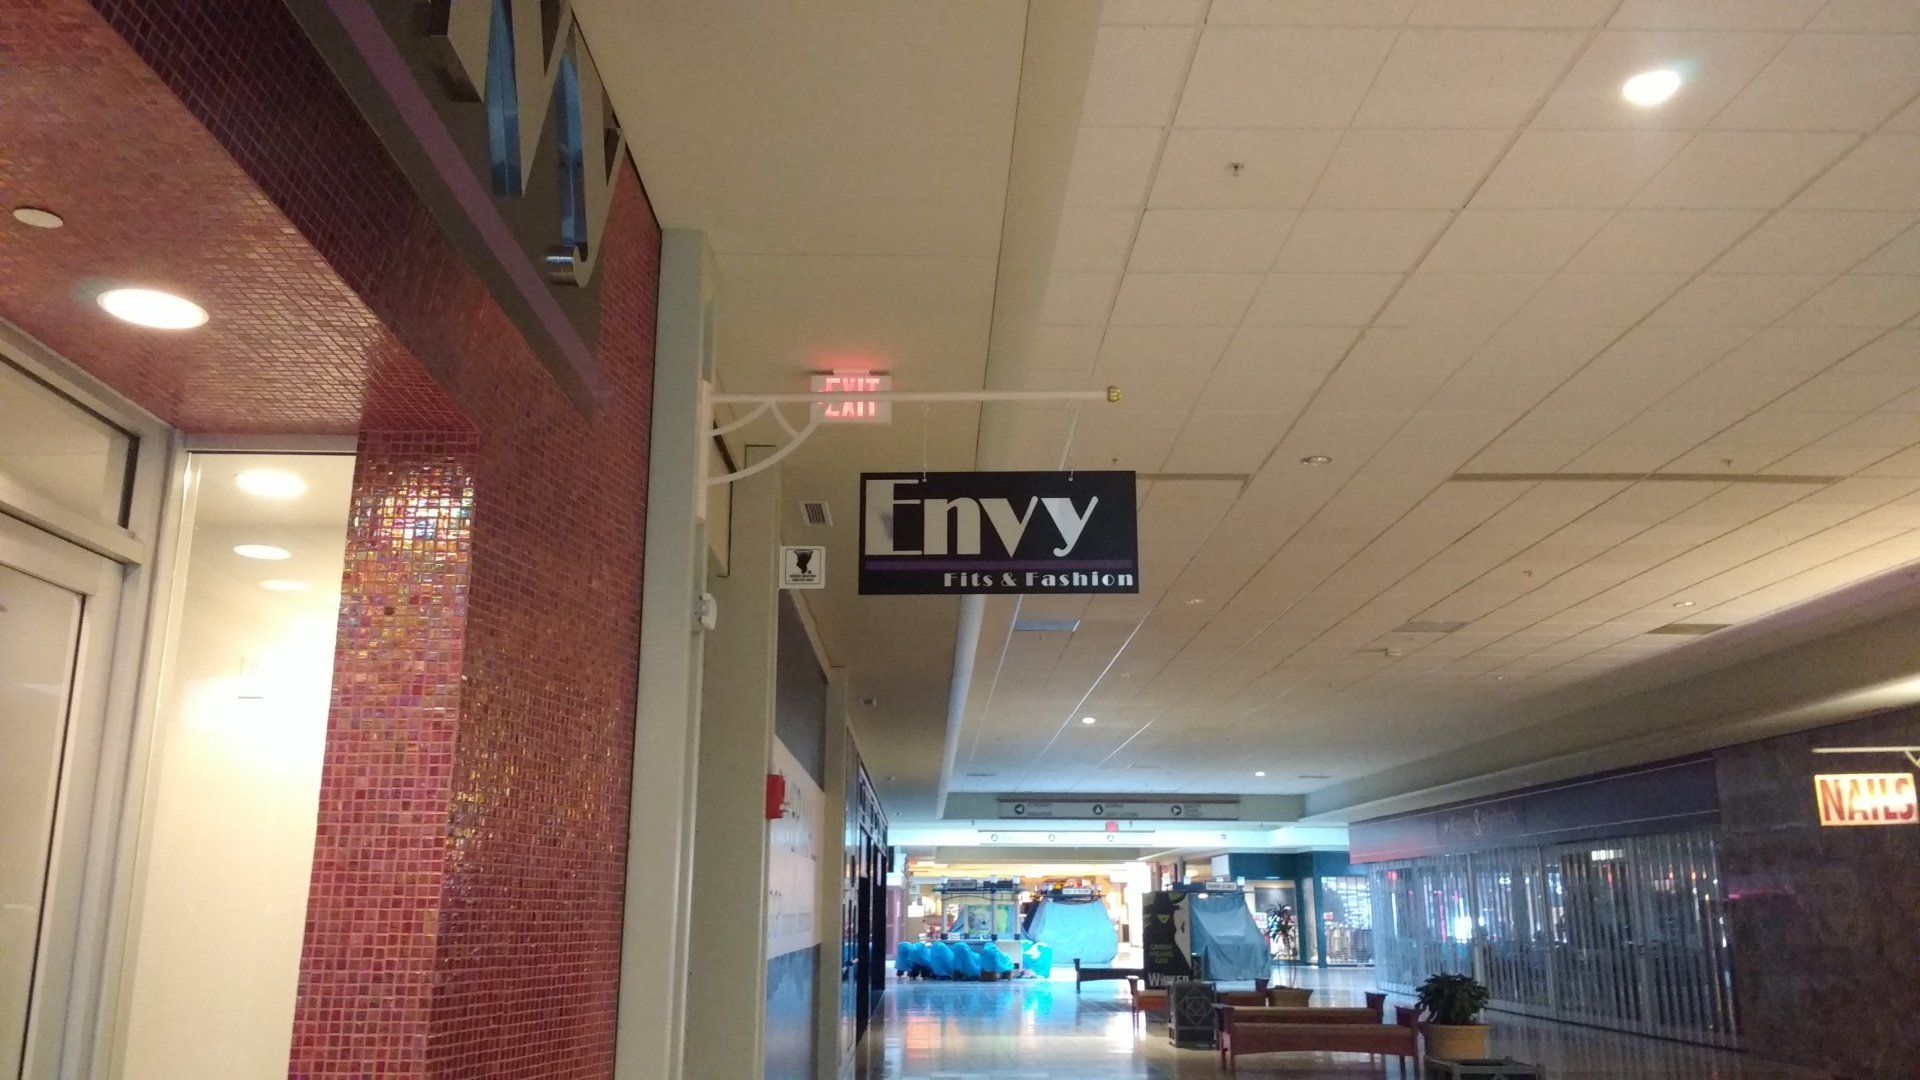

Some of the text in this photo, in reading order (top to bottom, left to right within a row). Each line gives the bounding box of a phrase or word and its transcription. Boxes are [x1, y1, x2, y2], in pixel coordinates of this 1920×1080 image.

[825, 377, 880, 417] EXIT
[864, 479, 1099, 558] Envy
[943, 571, 1134, 587] Fits & Fashion
[1819, 777, 1914, 821] NAILS
